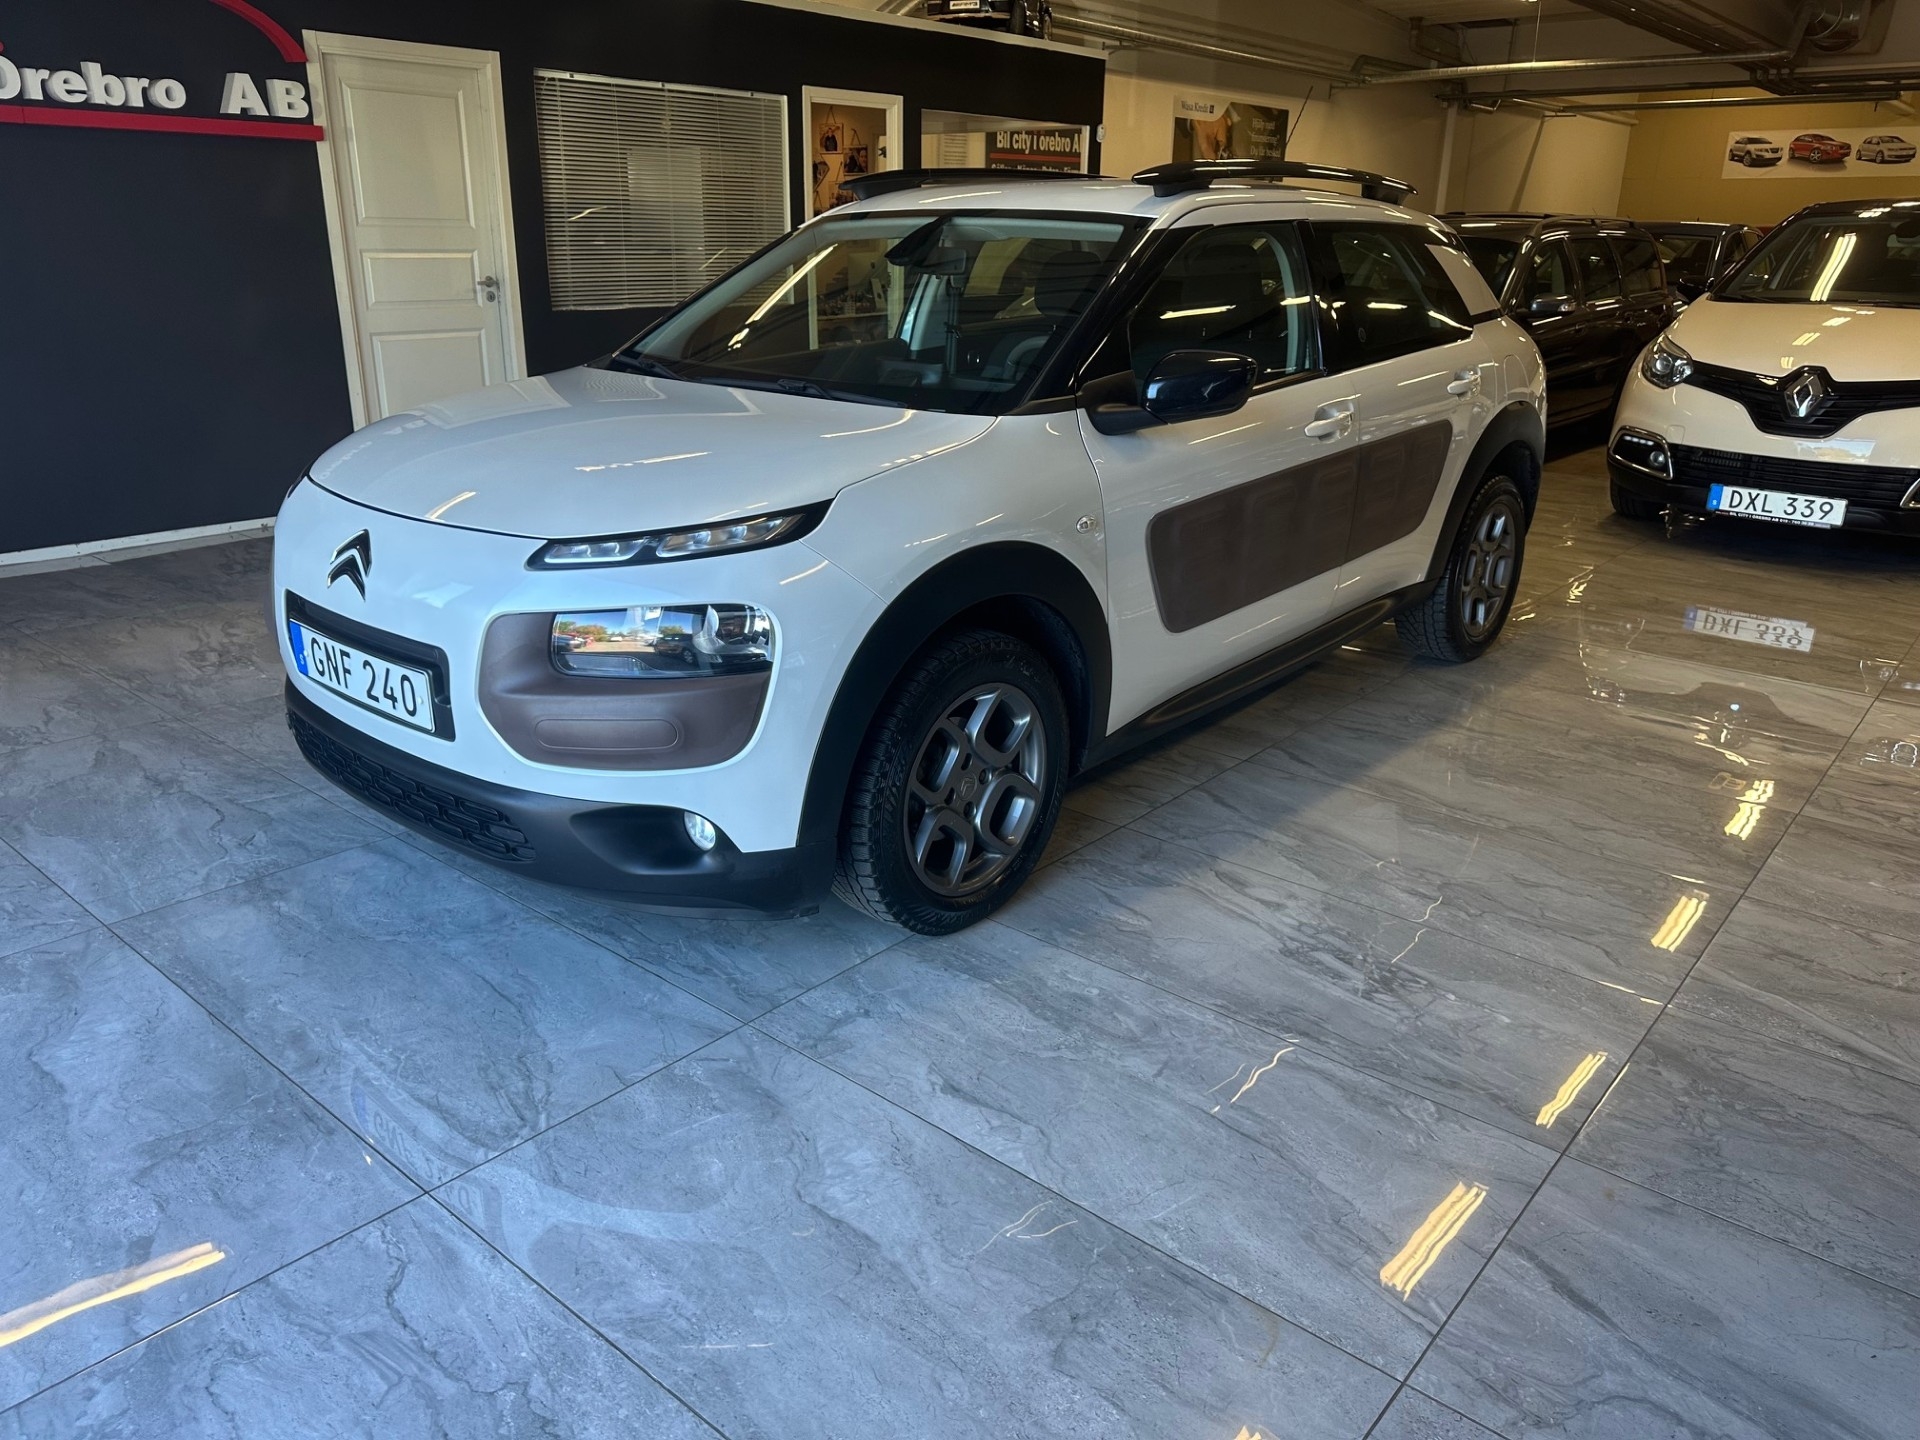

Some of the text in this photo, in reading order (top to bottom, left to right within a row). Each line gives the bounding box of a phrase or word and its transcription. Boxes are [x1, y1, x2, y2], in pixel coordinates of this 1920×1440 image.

[220, 72, 310, 118] AB
[996, 131, 1011, 149] Bil
[1012, 131, 1031, 154] city
[1728, 489, 1773, 514] DXL
[1783, 496, 1834, 520] 339
[310, 637, 352, 690] GNF
[362, 659, 417, 718] 240
